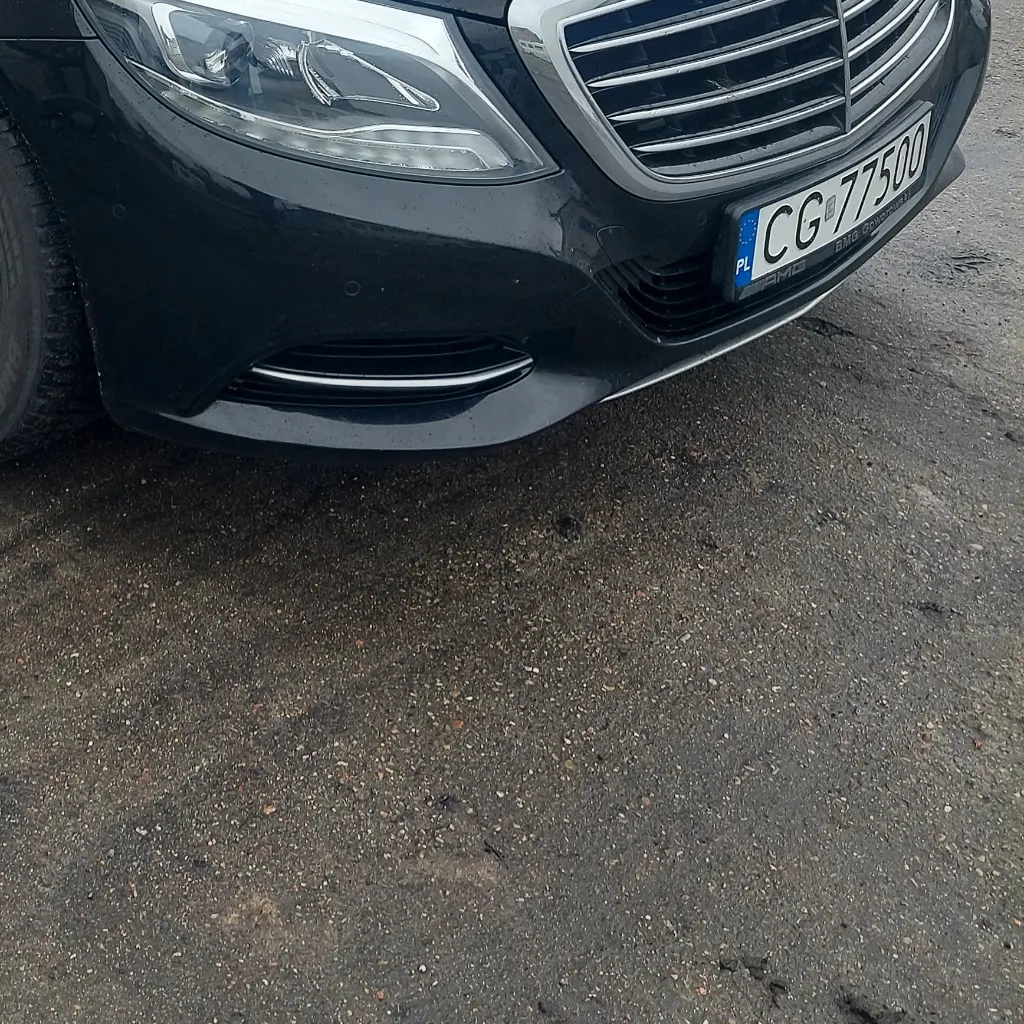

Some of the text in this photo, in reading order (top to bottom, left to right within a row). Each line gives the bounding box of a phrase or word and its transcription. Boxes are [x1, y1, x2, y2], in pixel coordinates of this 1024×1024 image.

[764, 123, 925, 264] CG 77500
[835, 230, 859, 252] BMG
[735, 256, 751, 276] PL
